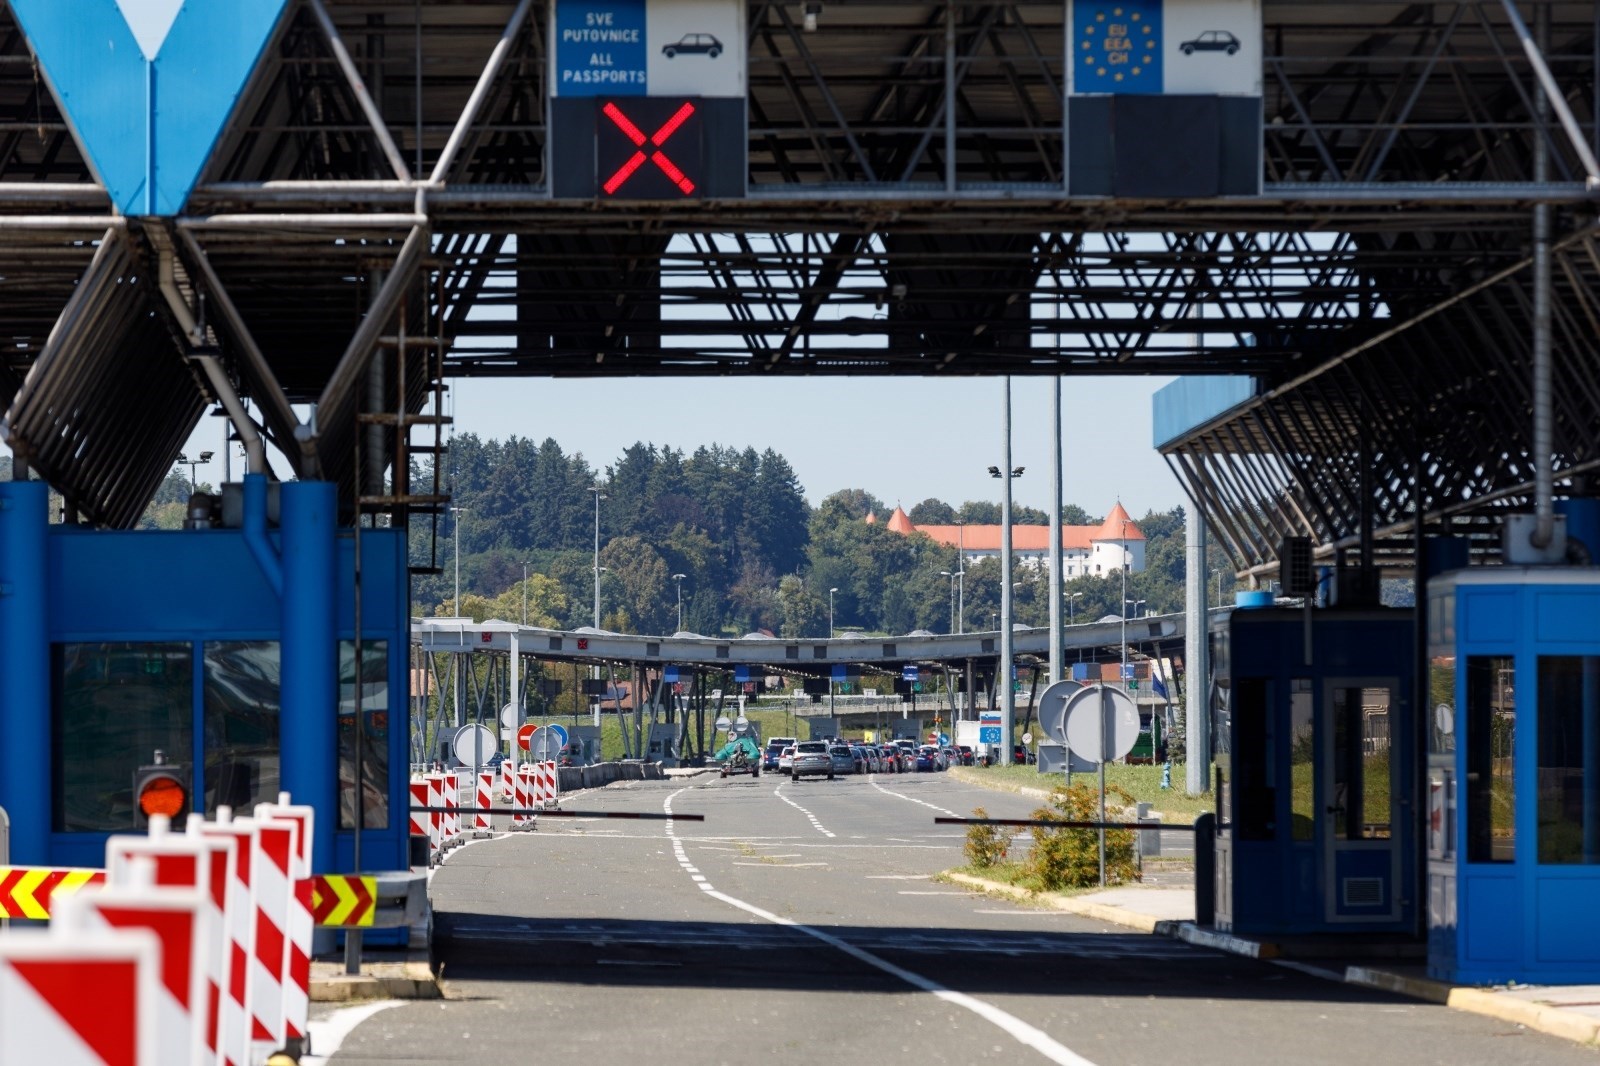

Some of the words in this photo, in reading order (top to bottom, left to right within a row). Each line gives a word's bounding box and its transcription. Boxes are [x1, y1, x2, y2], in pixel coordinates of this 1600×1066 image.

[586, 12, 613, 26] SVE
[563, 29, 639, 42] PUTOVNICE
[1108, 24, 1127, 37] EU
[1104, 39, 1132, 50] EEA
[589, 53, 613, 66] ALL
[1108, 52, 1128, 64] CH
[563, 69, 646, 83] PASSPORTS
